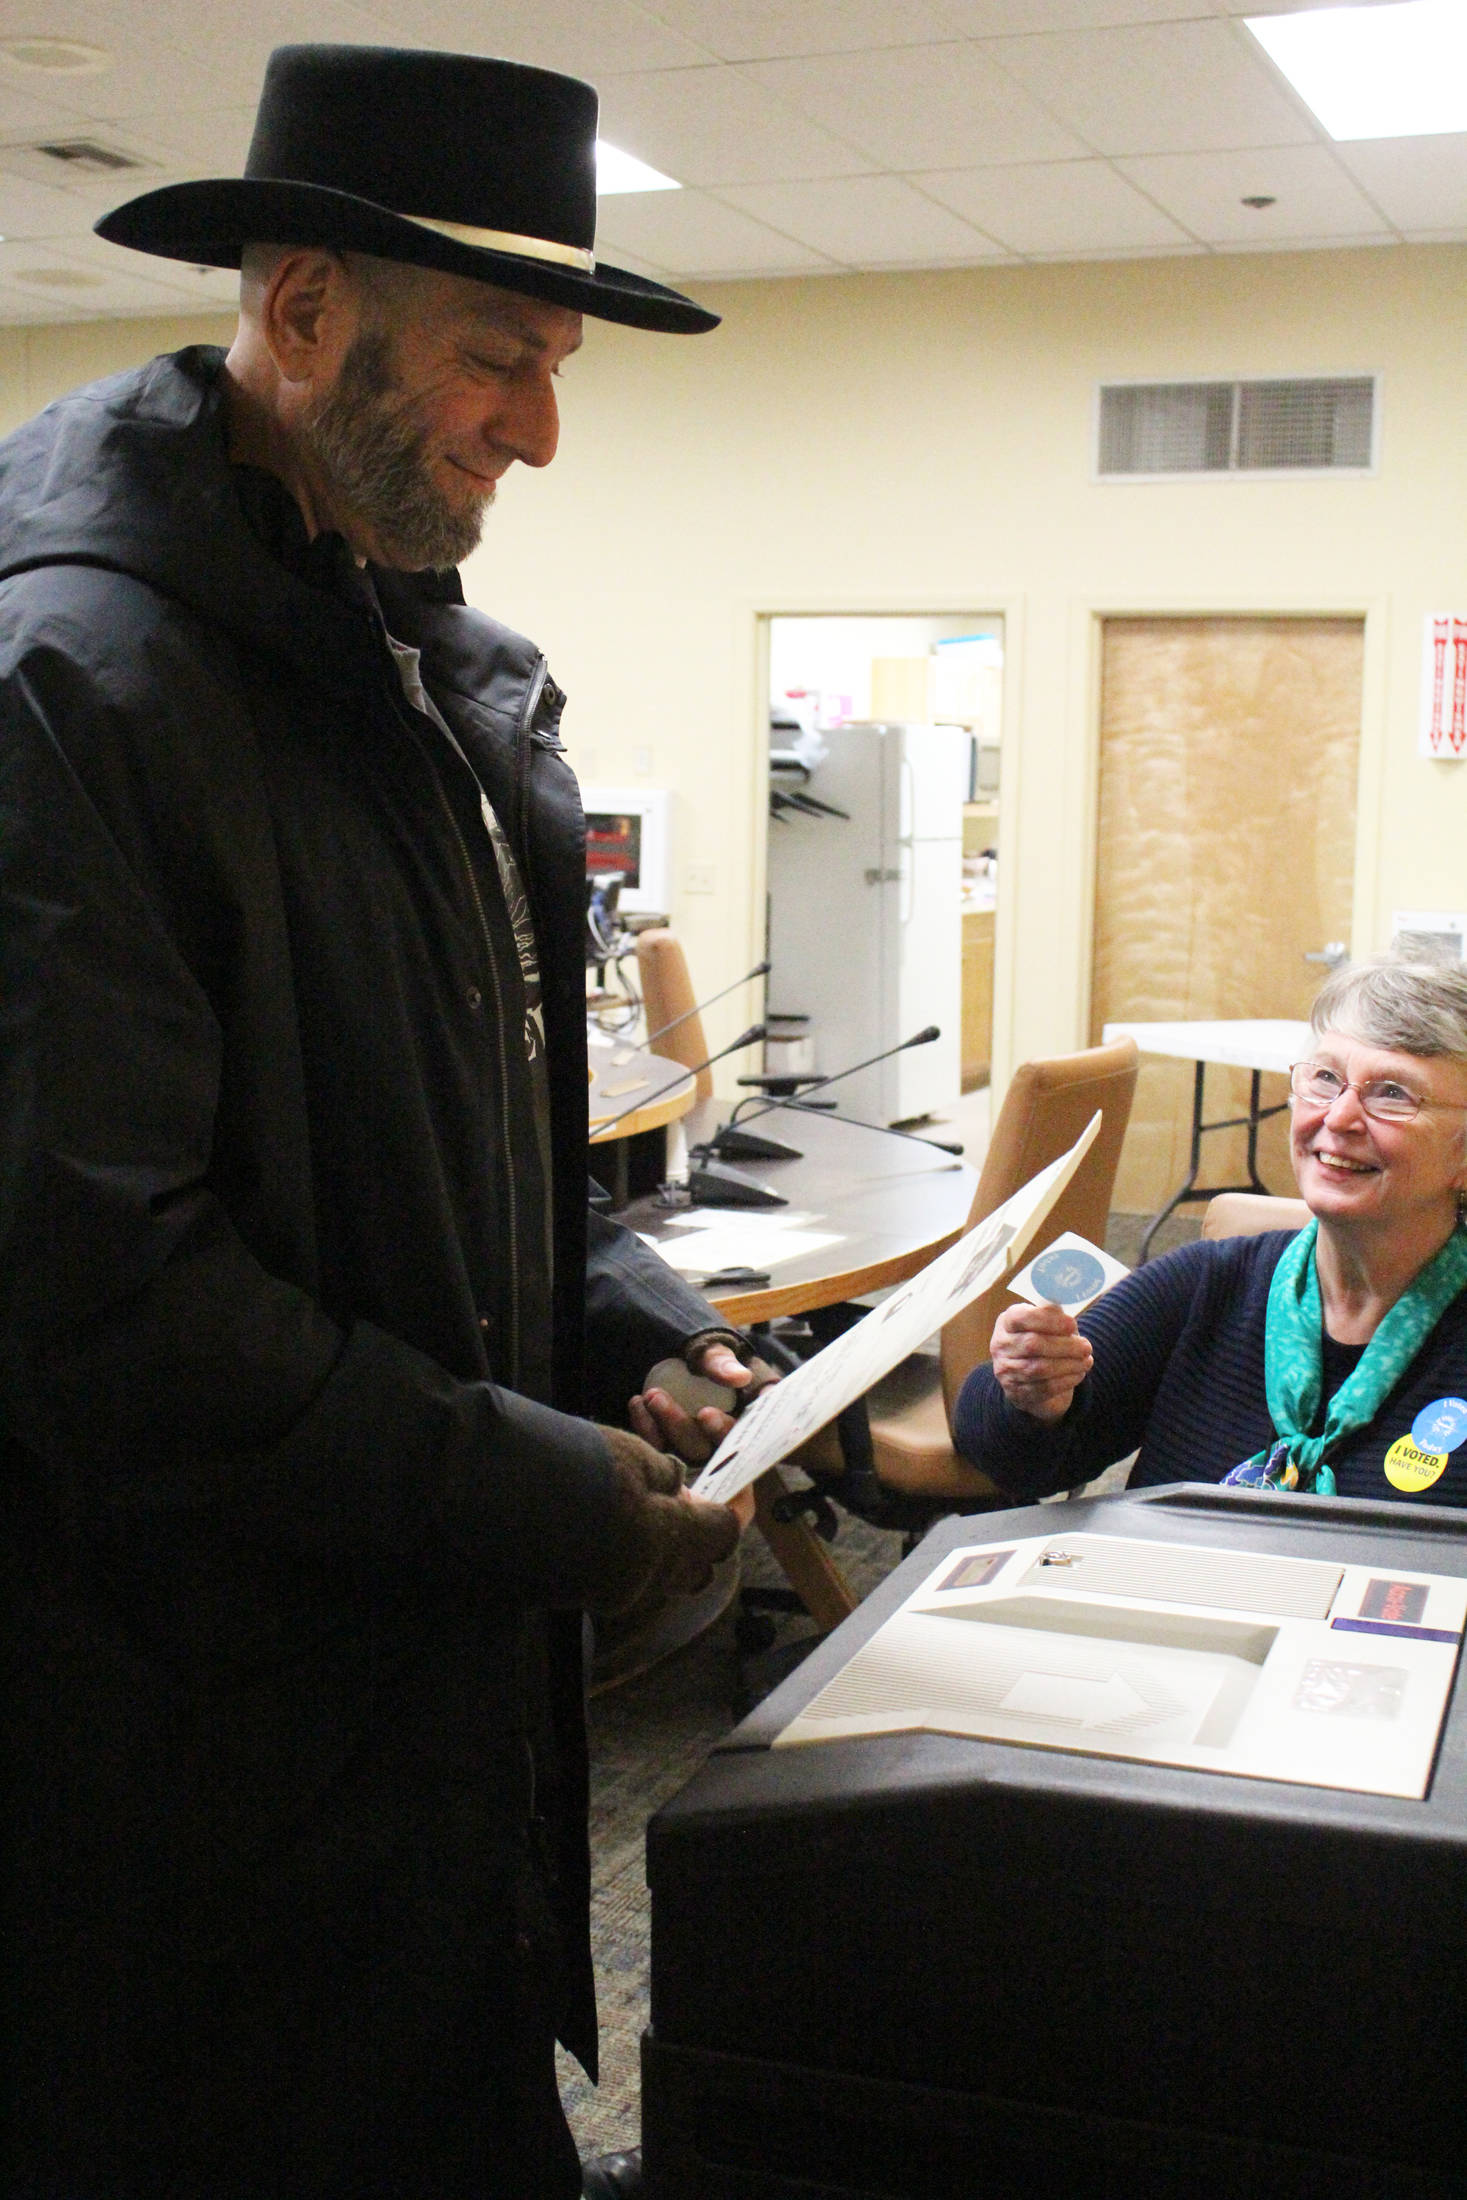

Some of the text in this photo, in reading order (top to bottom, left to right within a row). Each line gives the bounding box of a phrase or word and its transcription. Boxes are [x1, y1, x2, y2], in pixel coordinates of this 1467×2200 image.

[1389, 1457, 1436, 1480] HAVE YOU?
[1394, 1444, 1440, 1469] I VOTED.
